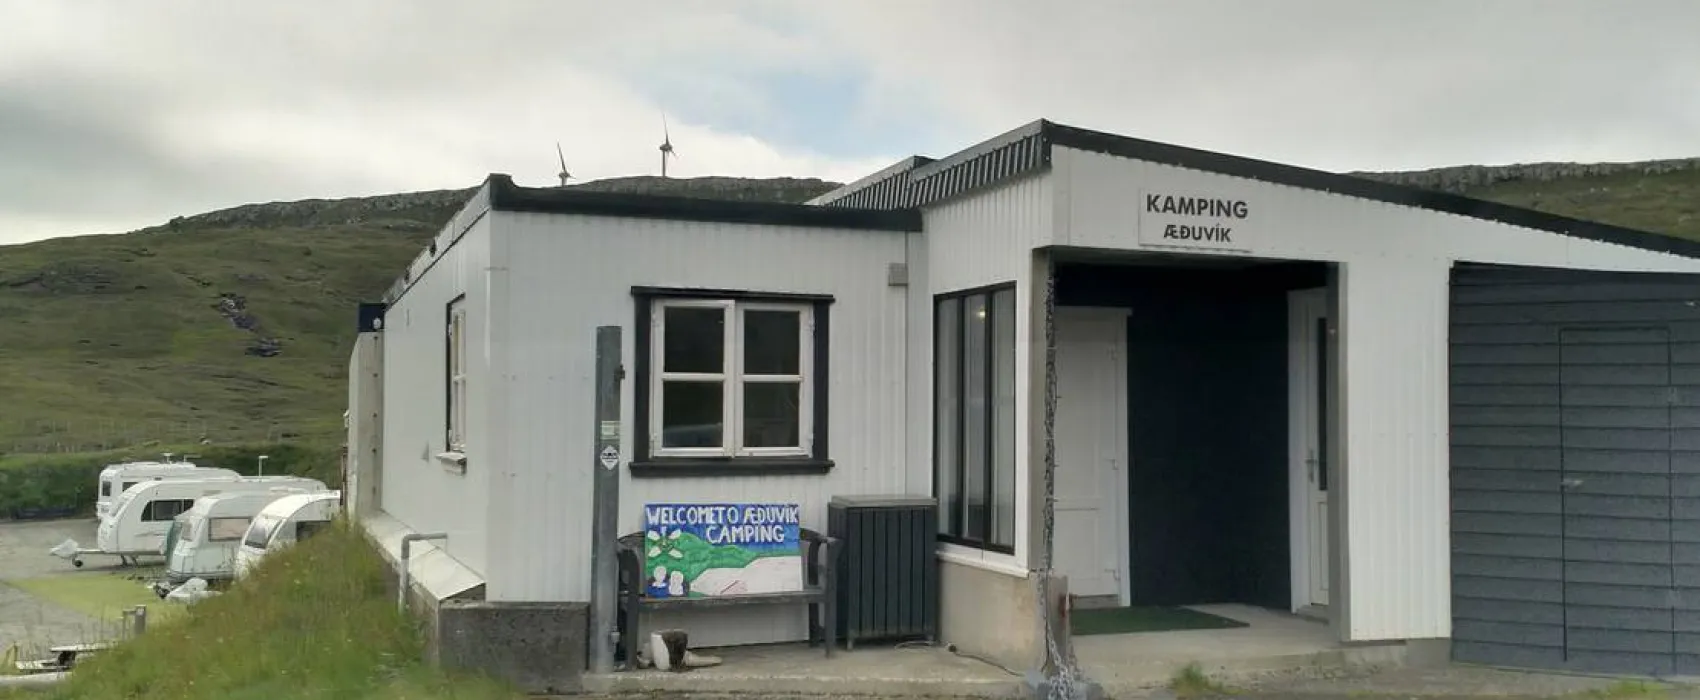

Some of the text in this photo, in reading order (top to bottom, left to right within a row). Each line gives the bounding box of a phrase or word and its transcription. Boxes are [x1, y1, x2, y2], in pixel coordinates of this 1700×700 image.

[1146, 193, 1248, 219] KAMPING
[1163, 222, 1232, 242] ÆÐUVÍK
[706, 524, 785, 543] CAMPING
